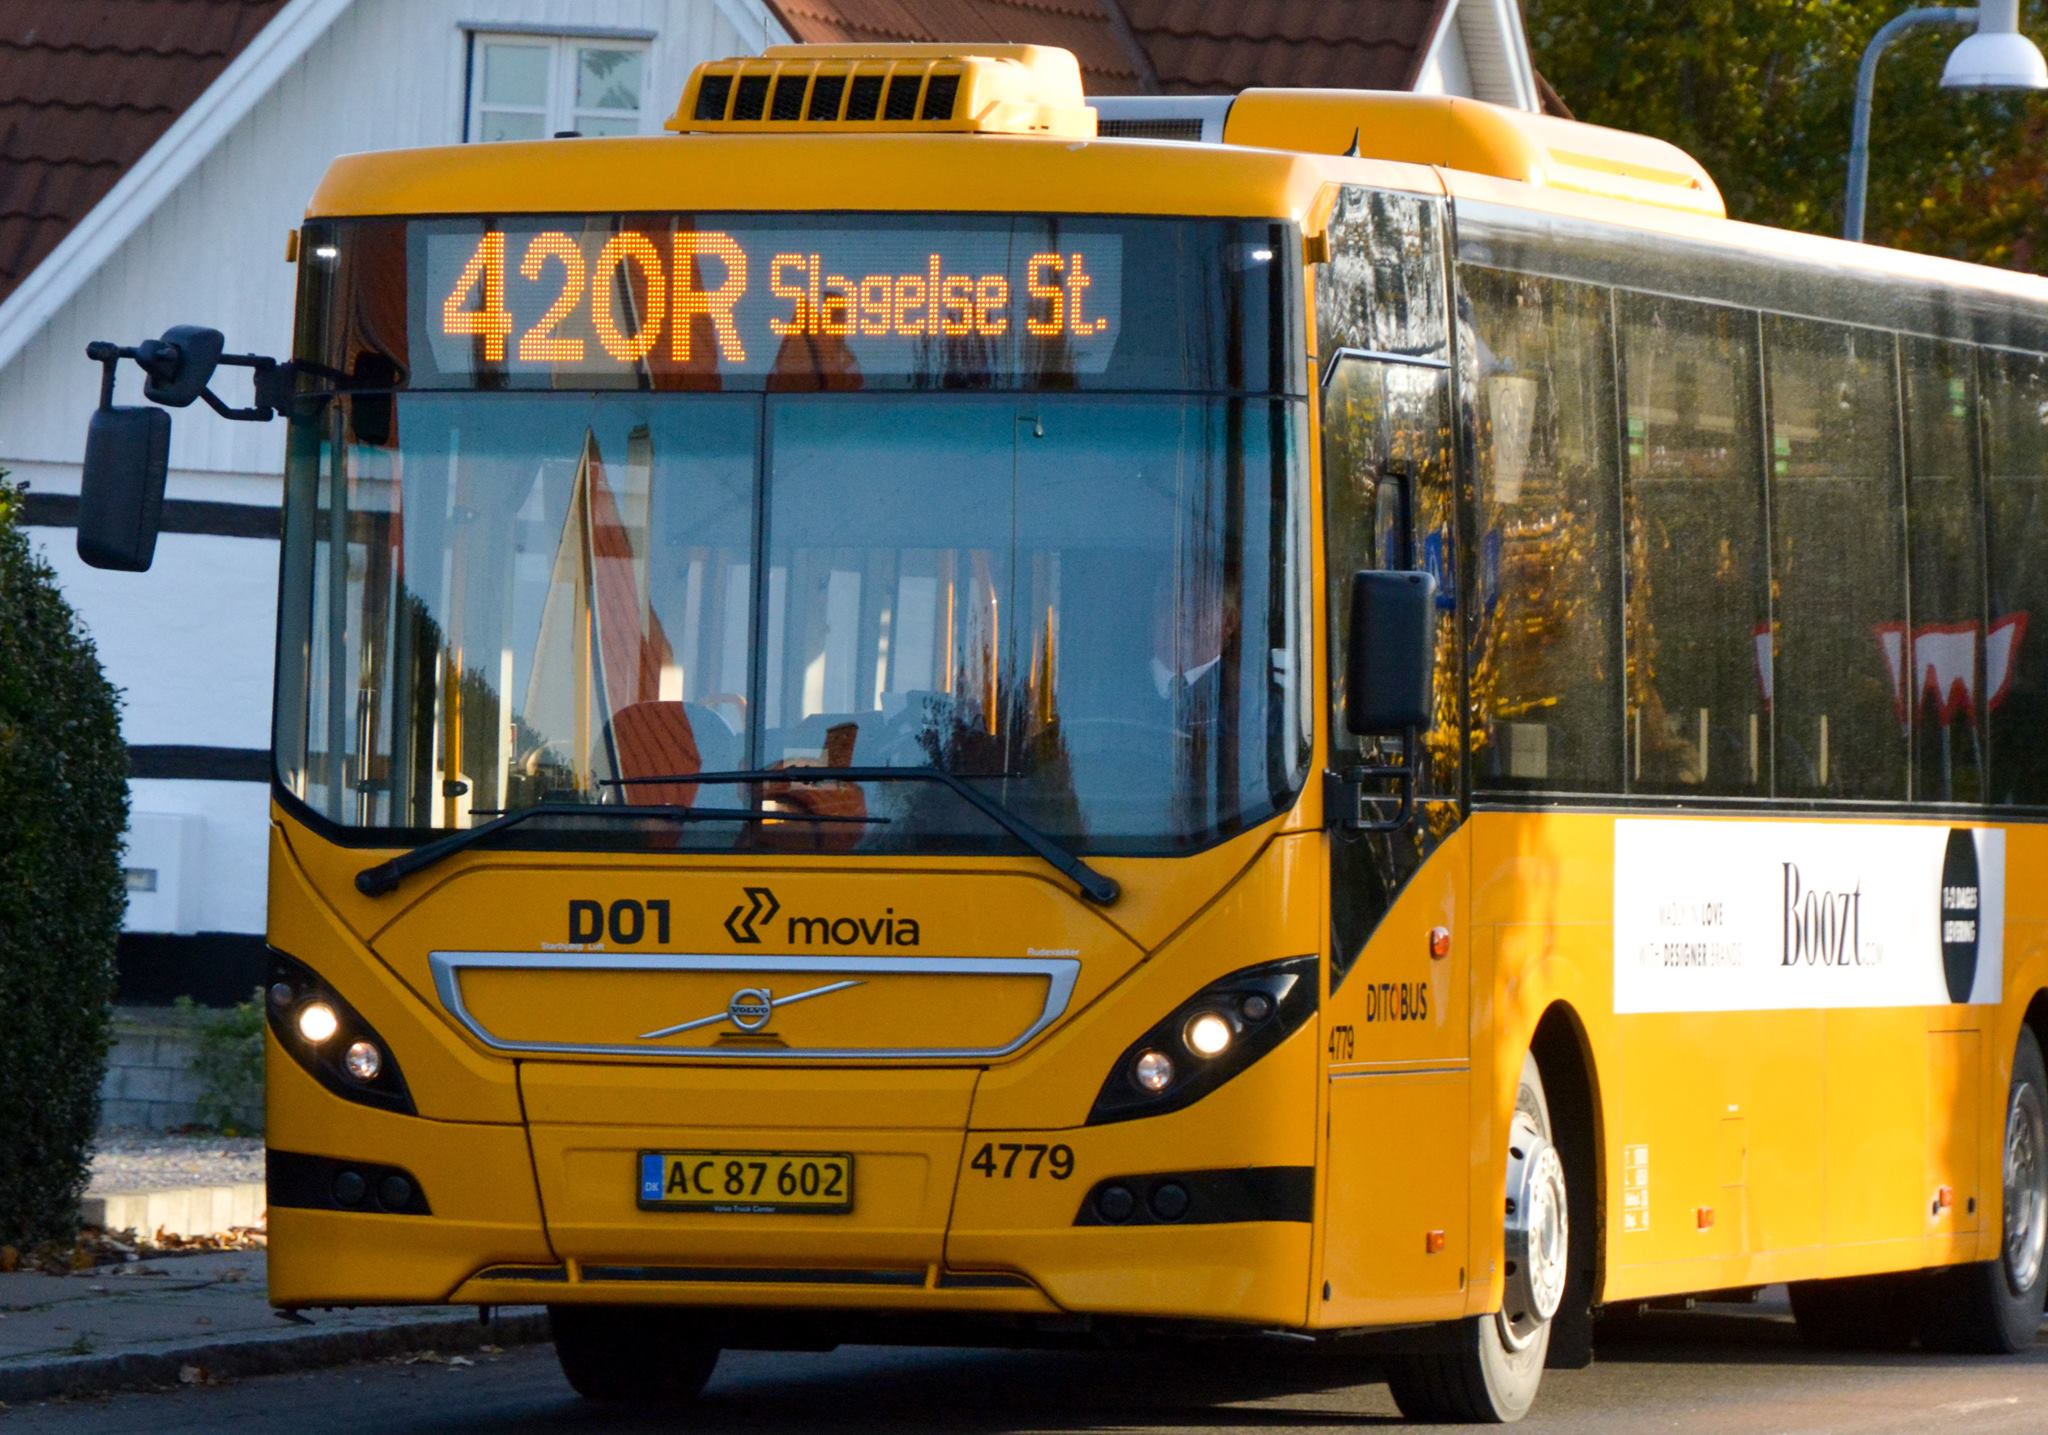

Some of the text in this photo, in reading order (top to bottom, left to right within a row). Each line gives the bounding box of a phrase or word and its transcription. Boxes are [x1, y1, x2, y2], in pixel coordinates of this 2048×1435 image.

[444, 231, 1108, 362] 420R Slagelse St.
[788, 907, 920, 945] movia
[1702, 902, 1723, 926] LOVE
[1663, 942, 1707, 967] DESIGNER
[731, 1006, 769, 1014] VOLVO
[1367, 983, 1427, 1022] DITOBUS
[1328, 1025, 1354, 1060] 4779
[666, 1160, 843, 1197] AC 87 602
[971, 1143, 1075, 1180] 4779
[644, 1180, 660, 1193] DK
